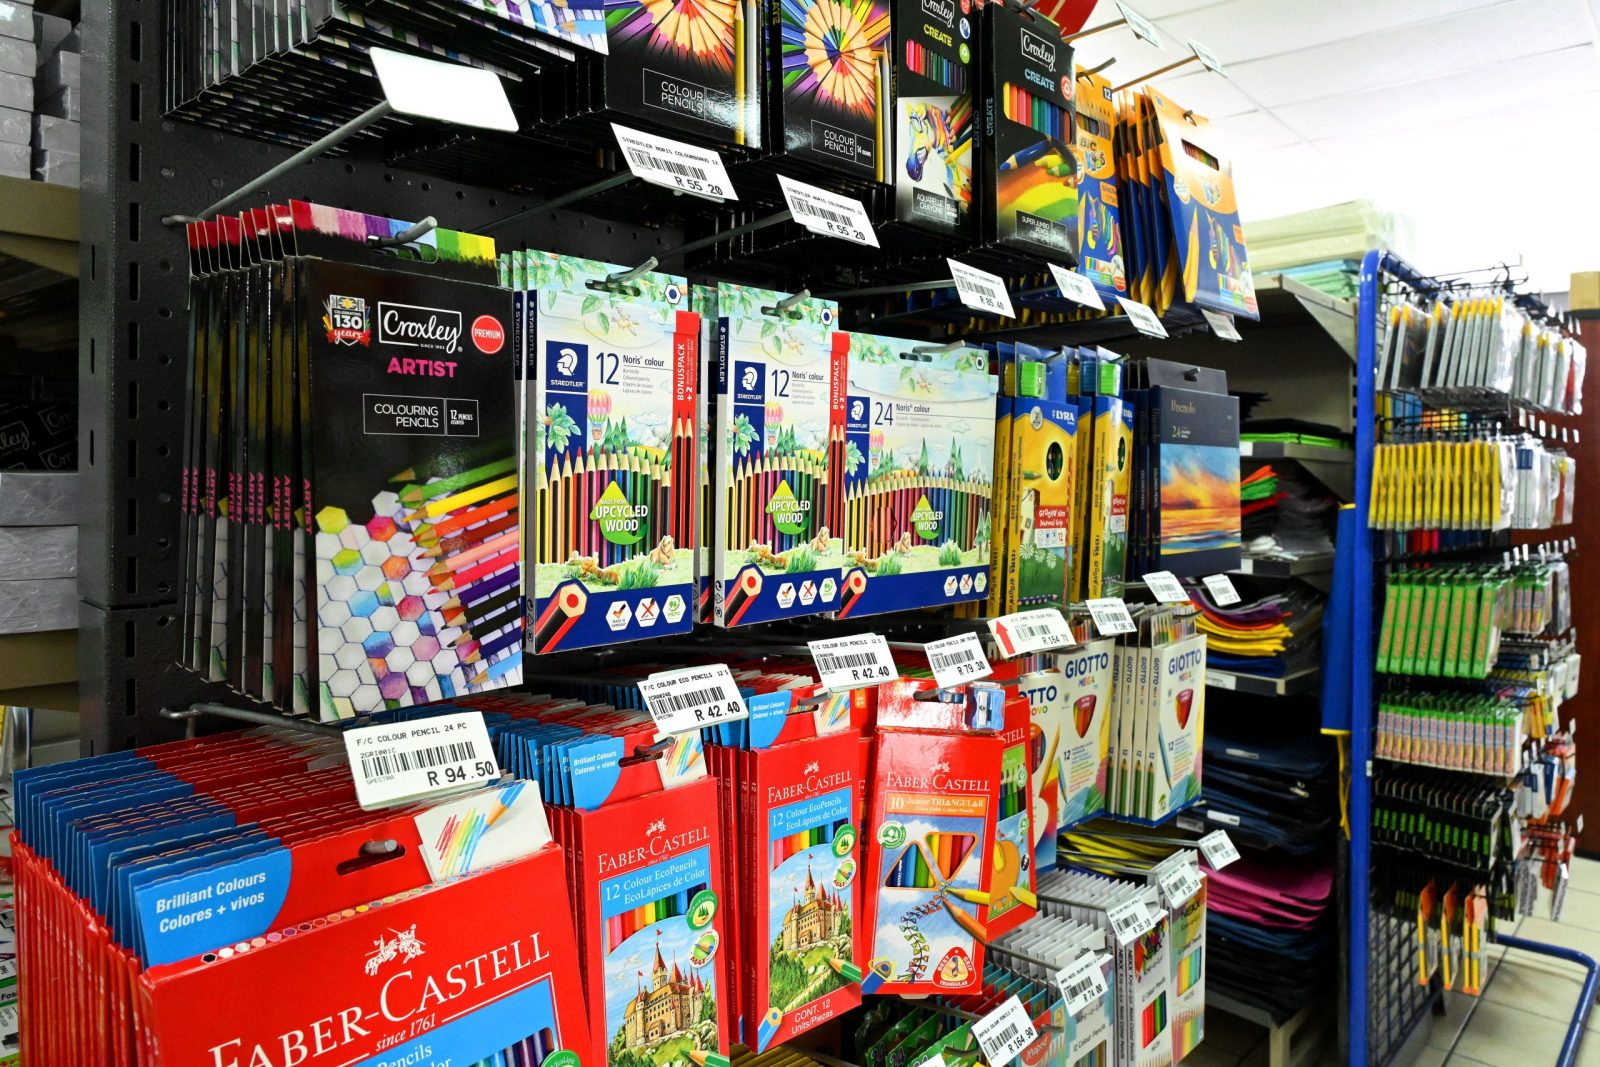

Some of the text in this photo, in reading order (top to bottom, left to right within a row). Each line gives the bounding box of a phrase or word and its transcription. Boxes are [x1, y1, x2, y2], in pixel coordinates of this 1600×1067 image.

[924, 24, 952, 47] CREATE
[1022, 32, 1055, 72] Croxley
[1024, 68, 1055, 92] CREATE
[661, 81, 704, 101] COLOUR
[1104, 86, 1112, 100] 12
[661, 92, 704, 113] PENCILS
[986, 98, 994, 136] CREATE
[824, 130, 854, 146] COLOUR
[824, 140, 854, 156] PENCILS
[674, 176, 684, 188] R
[827, 222, 834, 232] R
[334, 314, 362, 330] 130
[334, 328, 364, 344] years
[384, 310, 457, 354] Croxley
[474, 328, 501, 340] PREMIUM
[387, 356, 458, 378] ARTIST
[596, 352, 620, 386] 12
[644, 358, 664, 366] colour
[550, 379, 586, 388] STAEDTLER
[772, 370, 790, 398] 12
[808, 373, 824, 381] colour
[832, 359, 840, 410] BONUSPACK
[374, 404, 438, 416] COLOURING
[450, 410, 458, 420] 12
[875, 402, 894, 426] 24
[914, 405, 930, 414] colour
[1056, 410, 1074, 422] LYRA
[396, 416, 438, 428] PENCILS
[304, 478, 312, 536] ARTIST
[596, 505, 648, 518] UPCYCLED
[770, 500, 810, 512] UPCYCLED
[914, 510, 944, 521] UPCYCLED
[606, 520, 638, 532] WOOD
[778, 512, 802, 524] WOOD
[918, 520, 938, 530] WOOD
[1042, 636, 1048, 645] R
[957, 660, 986, 676] R 79.30
[1066, 652, 1108, 678] GIOTTO
[1168, 649, 1202, 676] GIOTTO
[644, 672, 713, 692] F/C COLOUR ECO PENCILS
[852, 666, 890, 680] R 42.40
[1078, 678, 1096, 688] MEGA
[694, 700, 740, 722] R 42.40
[752, 701, 785, 712] Brilliant Colours
[356, 722, 467, 746] F/C COLOUR PENCIL 24 PC
[1064, 750, 1071, 760] 12
[1168, 742, 1174, 750] 12
[574, 750, 617, 766] Brilliant Colours
[427, 761, 494, 786] R 94.50
[574, 760, 616, 776] Colores vivos
[768, 770, 852, 804] FABER-CASTELL
[886, 772, 990, 792] FABER-CASTELL
[772, 796, 842, 826] 12 Colour EcoPencils
[890, 796, 904, 810] 10
[932, 798, 984, 808] TRIANGULAR
[786, 806, 848, 831] EcoLápices de Color
[598, 826, 710, 874] FABER-CASTELL
[606, 858, 696, 901] 12 Colour EcoPencils
[624, 868, 706, 904] EcoLápices de Color
[156, 870, 266, 914] Brilliant Colours
[158, 908, 212, 934] Colores
[230, 890, 265, 909] vivos
[937, 954, 950, 972] BEST
[963, 953, 973, 972] GRIP
[208, 932, 550, 1067] FABER-CASTELL
[794, 999, 831, 1023] CONT. 12
[792, 1010, 834, 1036] Units/Piezas
[376, 1014, 436, 1052] since 1761
[1008, 1044, 1014, 1054] R
